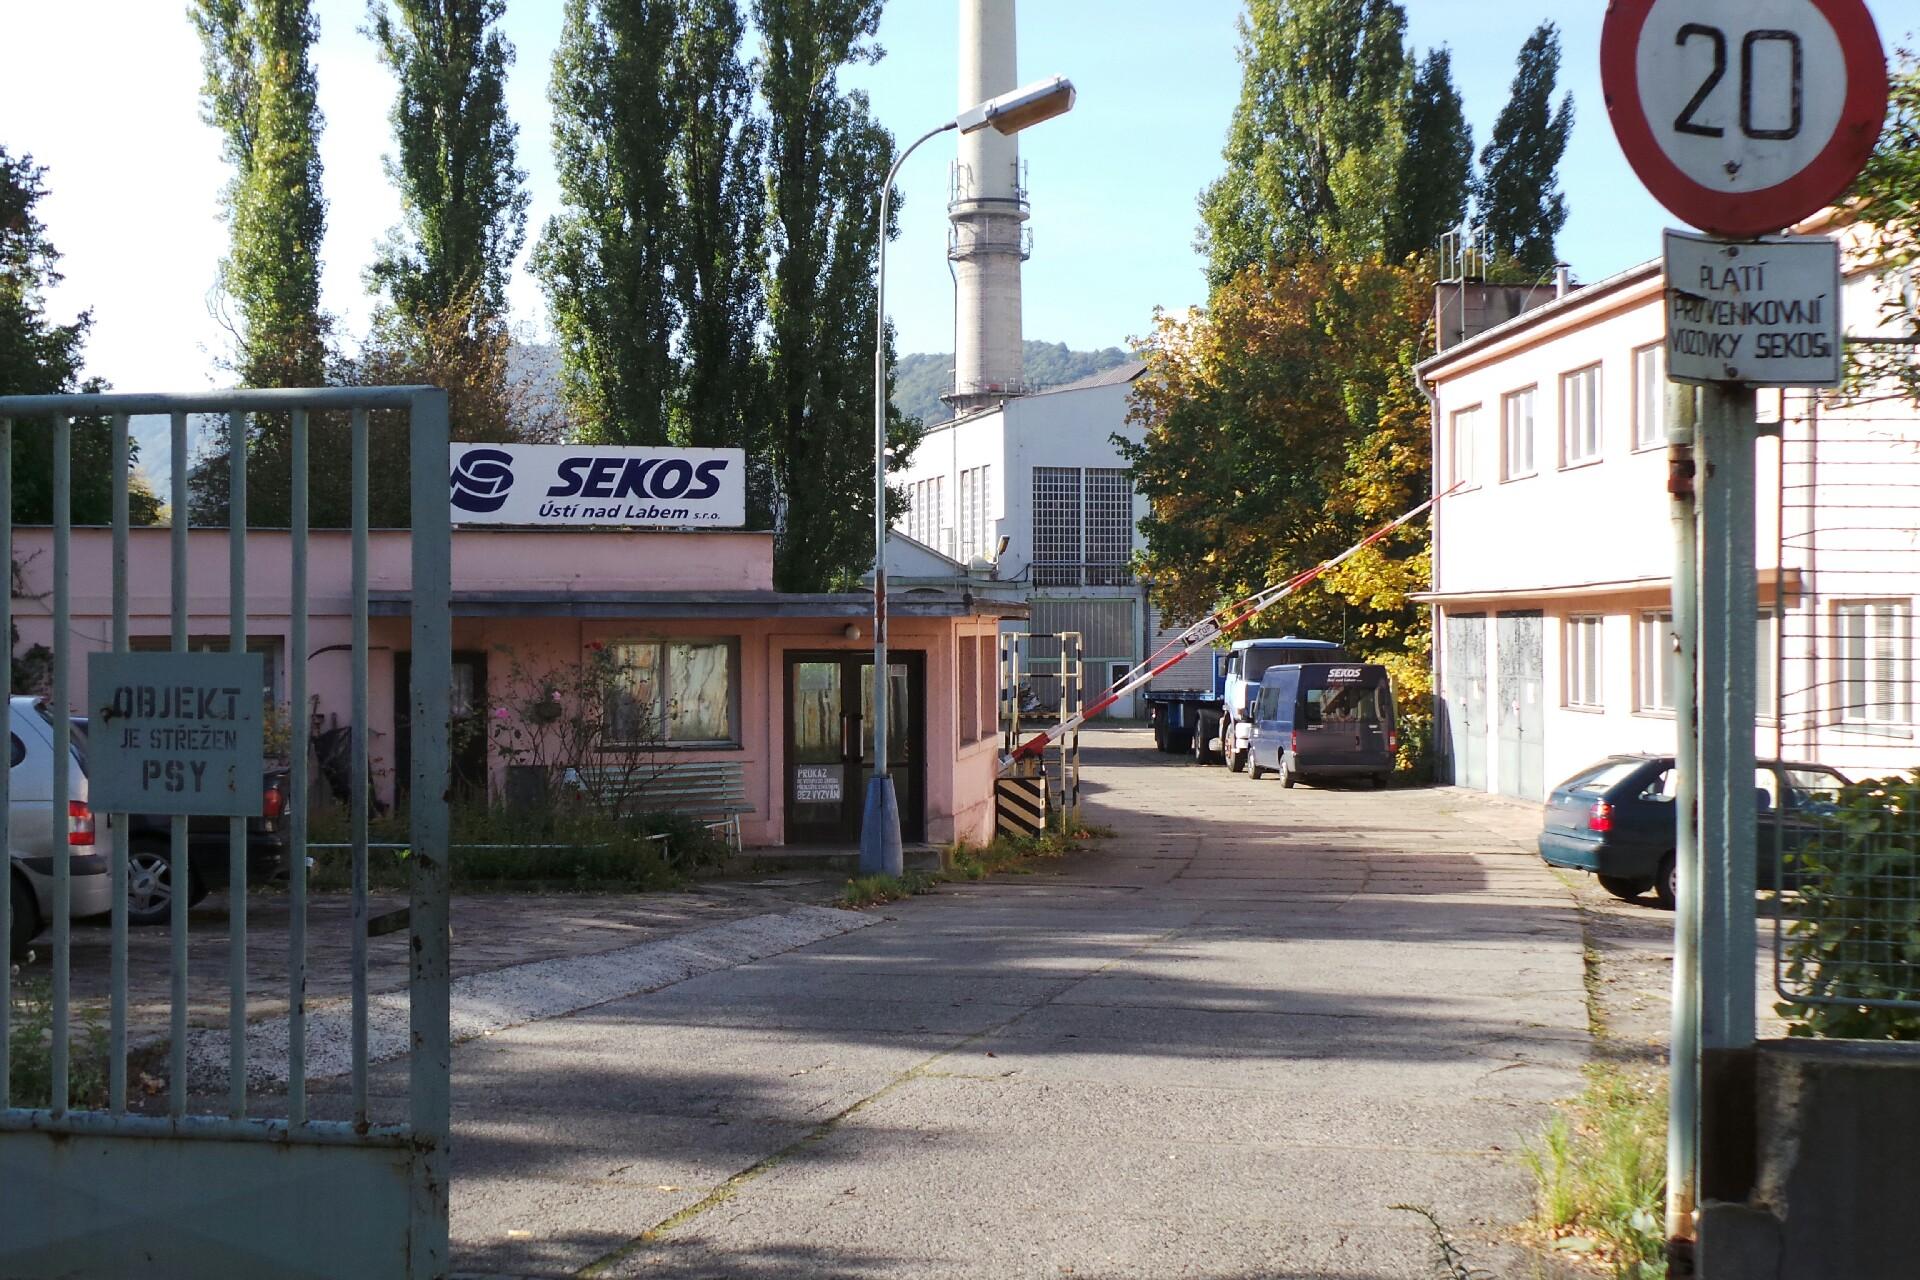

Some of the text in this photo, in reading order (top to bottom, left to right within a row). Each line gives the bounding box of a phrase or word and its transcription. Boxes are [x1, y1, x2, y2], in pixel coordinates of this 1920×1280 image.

[1674, 23, 1803, 140] 20
[1701, 261, 1768, 292] PLATÍ
[546, 457, 729, 499] SEKOS
[538, 501, 721, 520] Ústí nad Labem s.r.o.
[120, 728, 141, 749] JE
[142, 759, 207, 792] PSY
